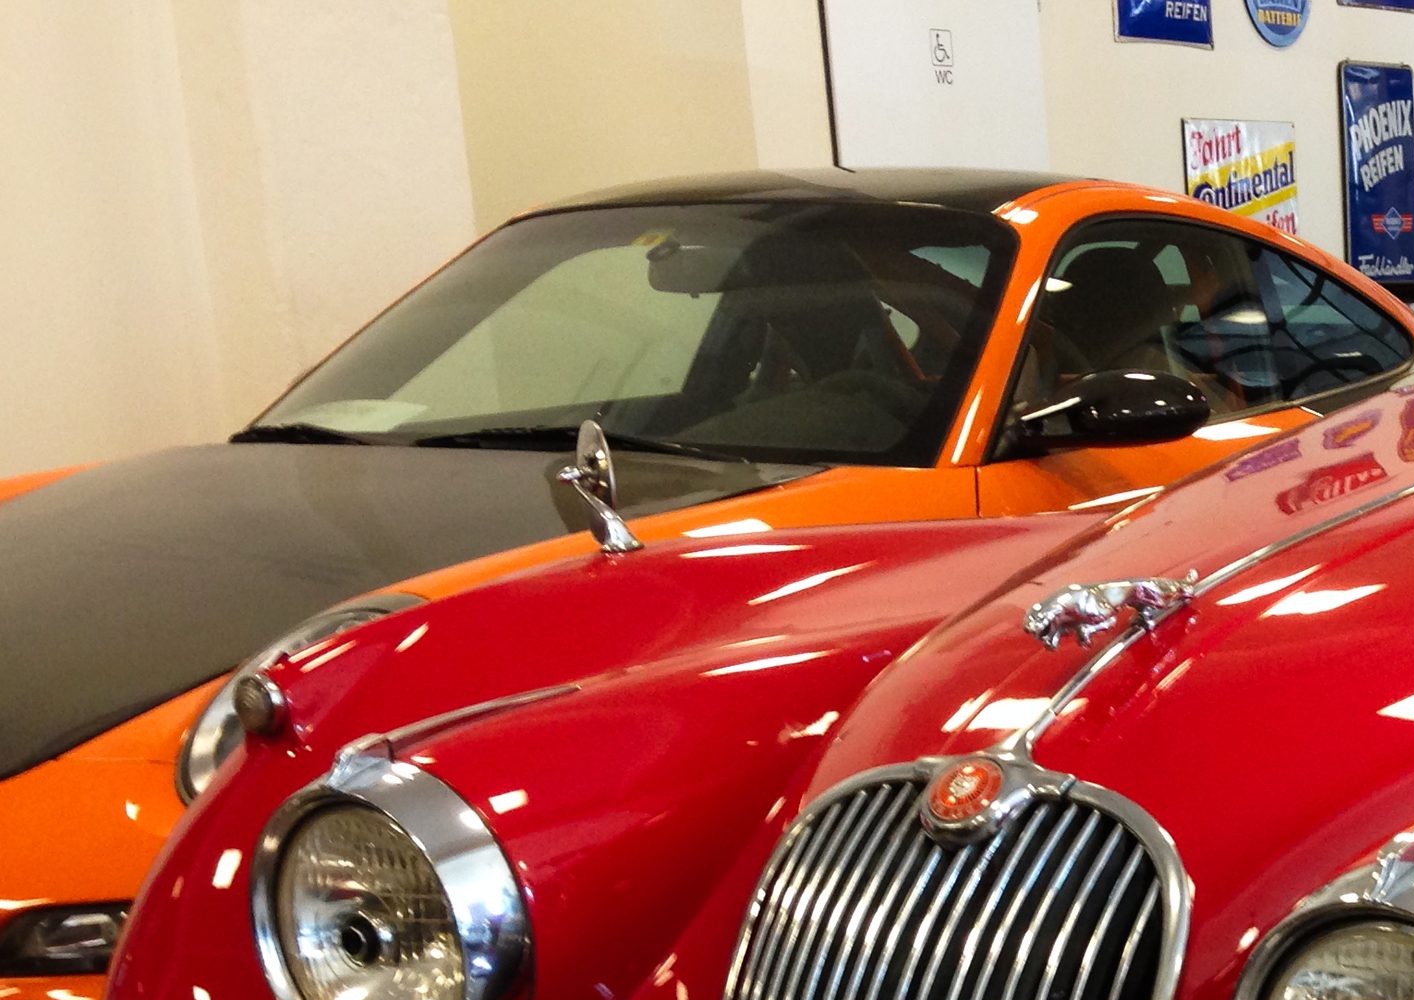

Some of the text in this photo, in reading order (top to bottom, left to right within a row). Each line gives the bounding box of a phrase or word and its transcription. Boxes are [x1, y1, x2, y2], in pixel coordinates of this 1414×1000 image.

[1165, 1, 1208, 21] REIFEN
[935, 70, 953, 85] WC
[1349, 100, 1412, 160] PHOENIX
[1360, 144, 1404, 192] REIFEN
